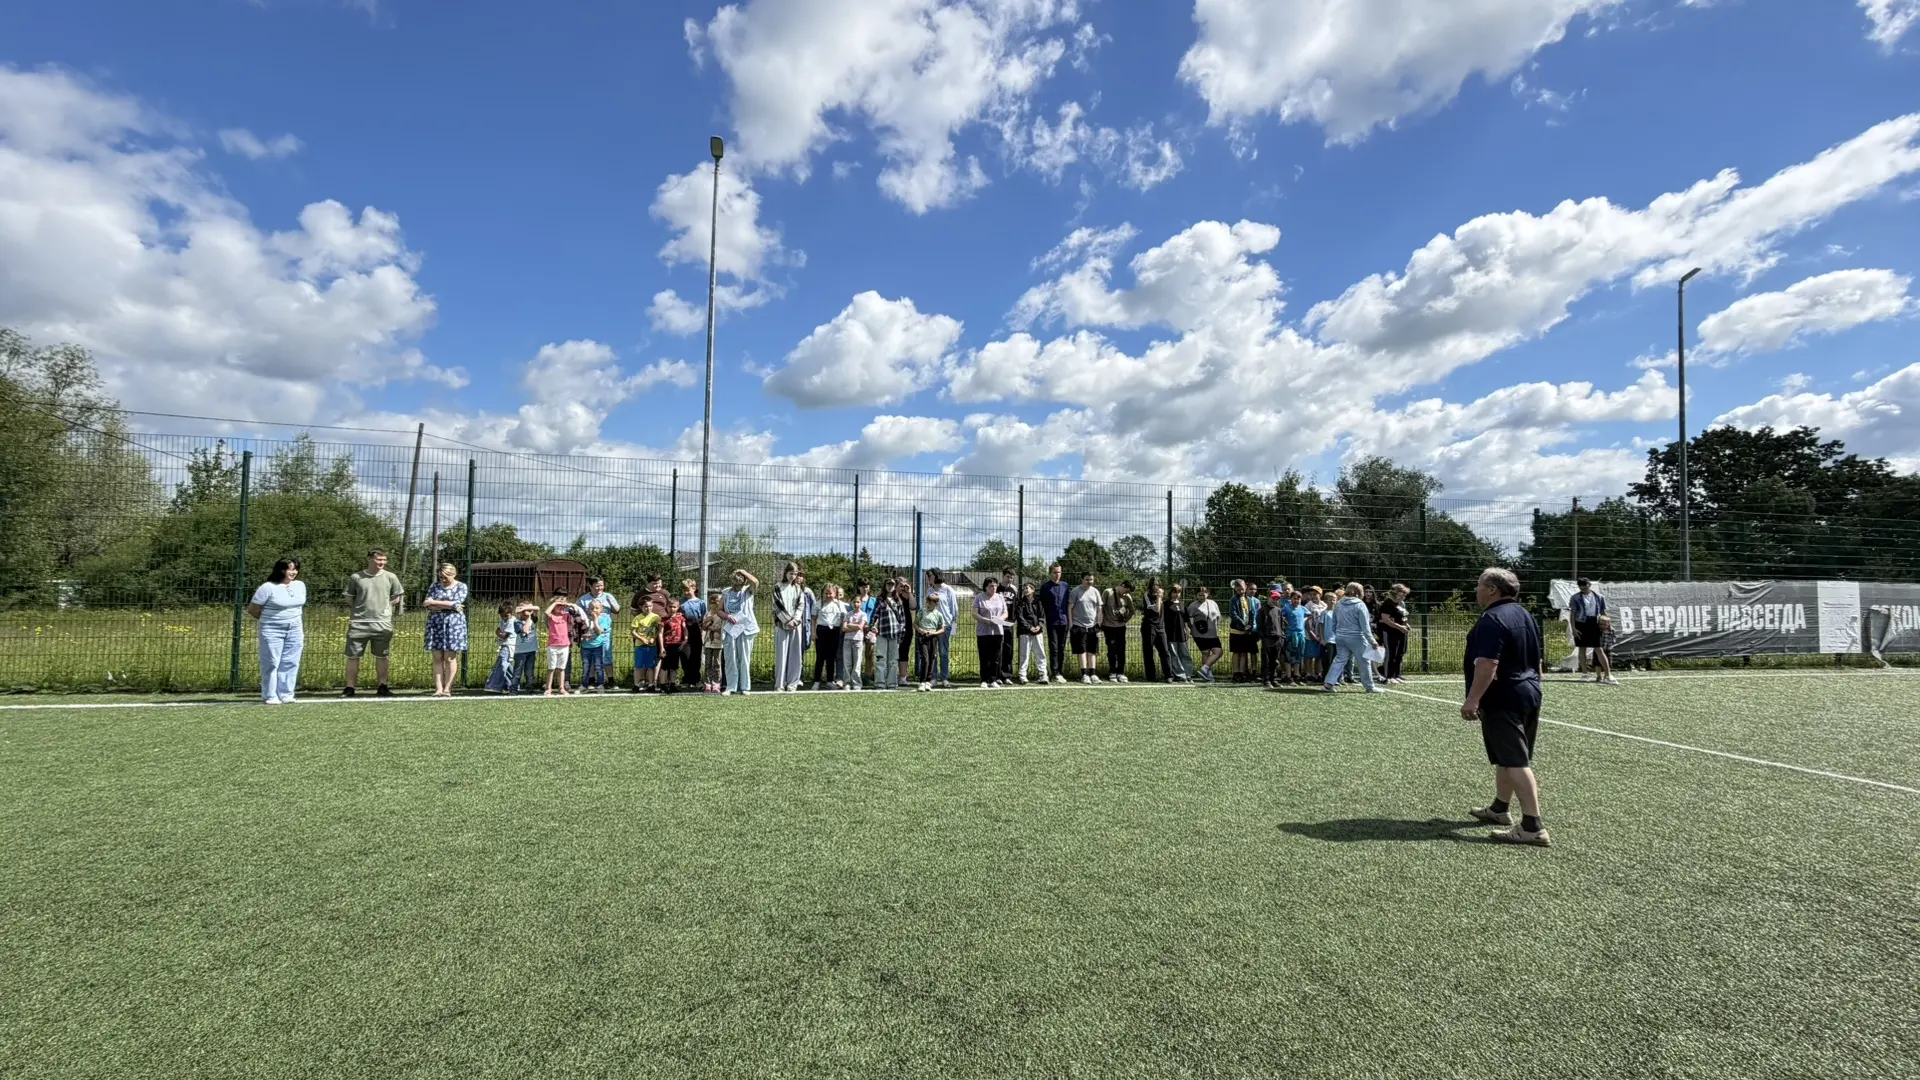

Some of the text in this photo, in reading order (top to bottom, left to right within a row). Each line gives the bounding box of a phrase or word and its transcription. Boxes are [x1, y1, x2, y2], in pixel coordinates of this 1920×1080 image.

[1620, 603, 1806, 637] В СЕРДЦЕ НАВСЕГДА
